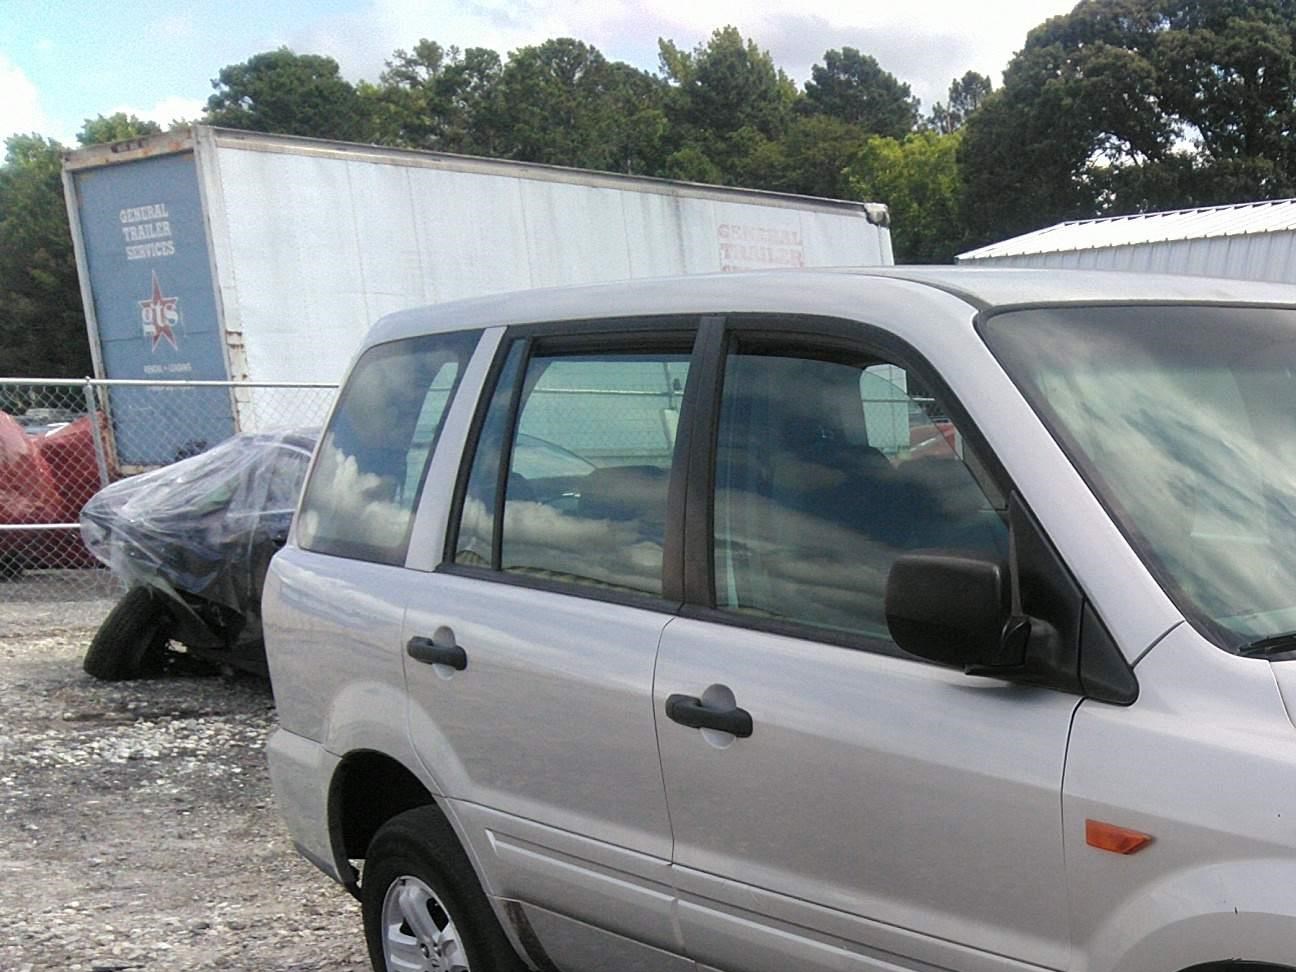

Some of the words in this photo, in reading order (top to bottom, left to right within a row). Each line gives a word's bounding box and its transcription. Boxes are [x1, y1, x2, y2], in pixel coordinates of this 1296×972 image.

[120, 203, 169, 223] GENERAL
[122, 221, 171, 241] TRAILER
[126, 240, 175, 260] SERVICES
